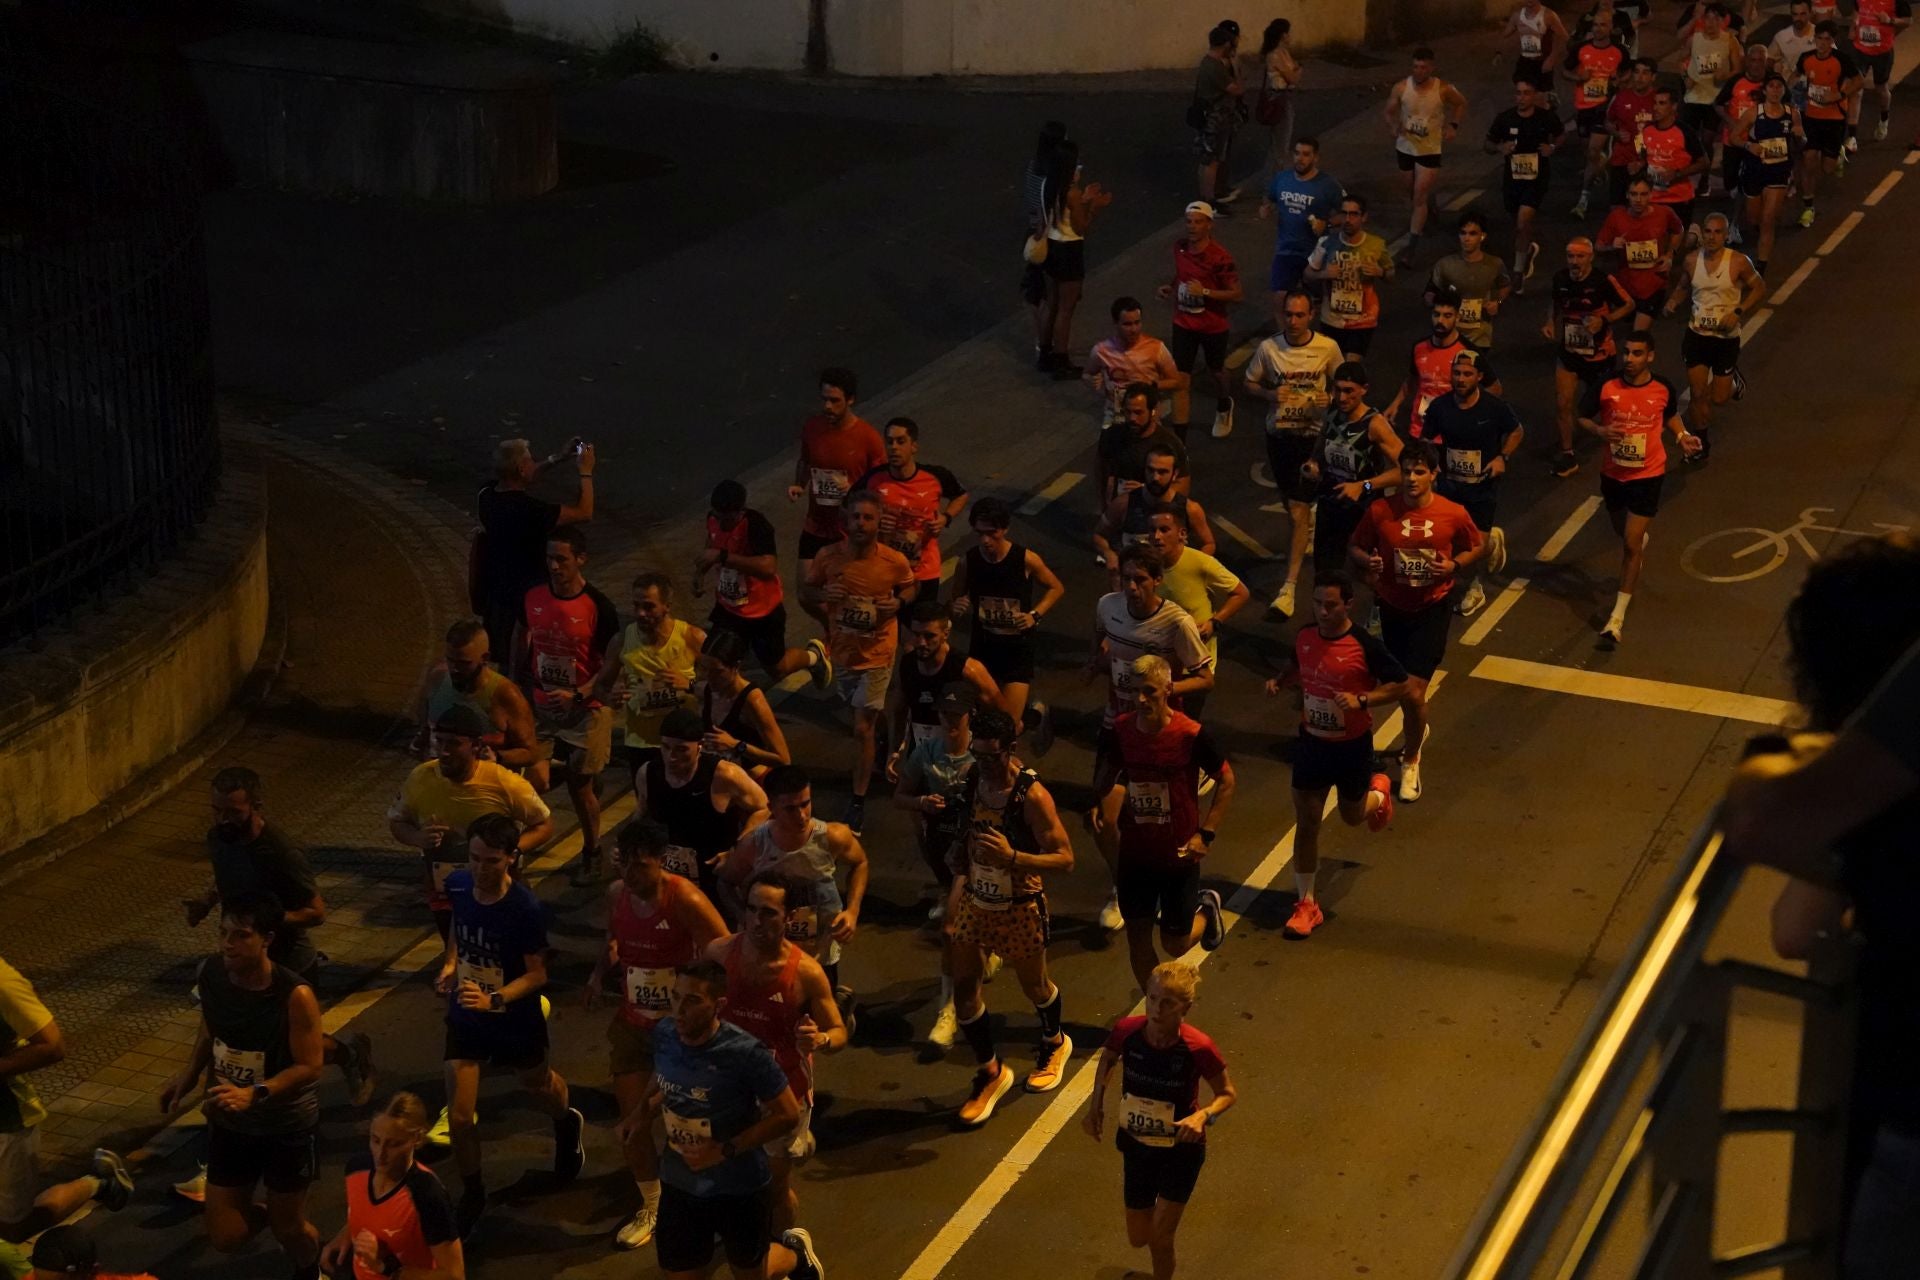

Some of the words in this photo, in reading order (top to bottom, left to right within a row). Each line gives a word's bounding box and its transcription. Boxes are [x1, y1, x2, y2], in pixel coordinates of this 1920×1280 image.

[1280, 191, 1315, 206] SPORT
[1336, 250, 1360, 261] ICH
[977, 879, 999, 894] 517
[635, 986, 669, 999] 2841
[1127, 1112, 1164, 1129] 3033
